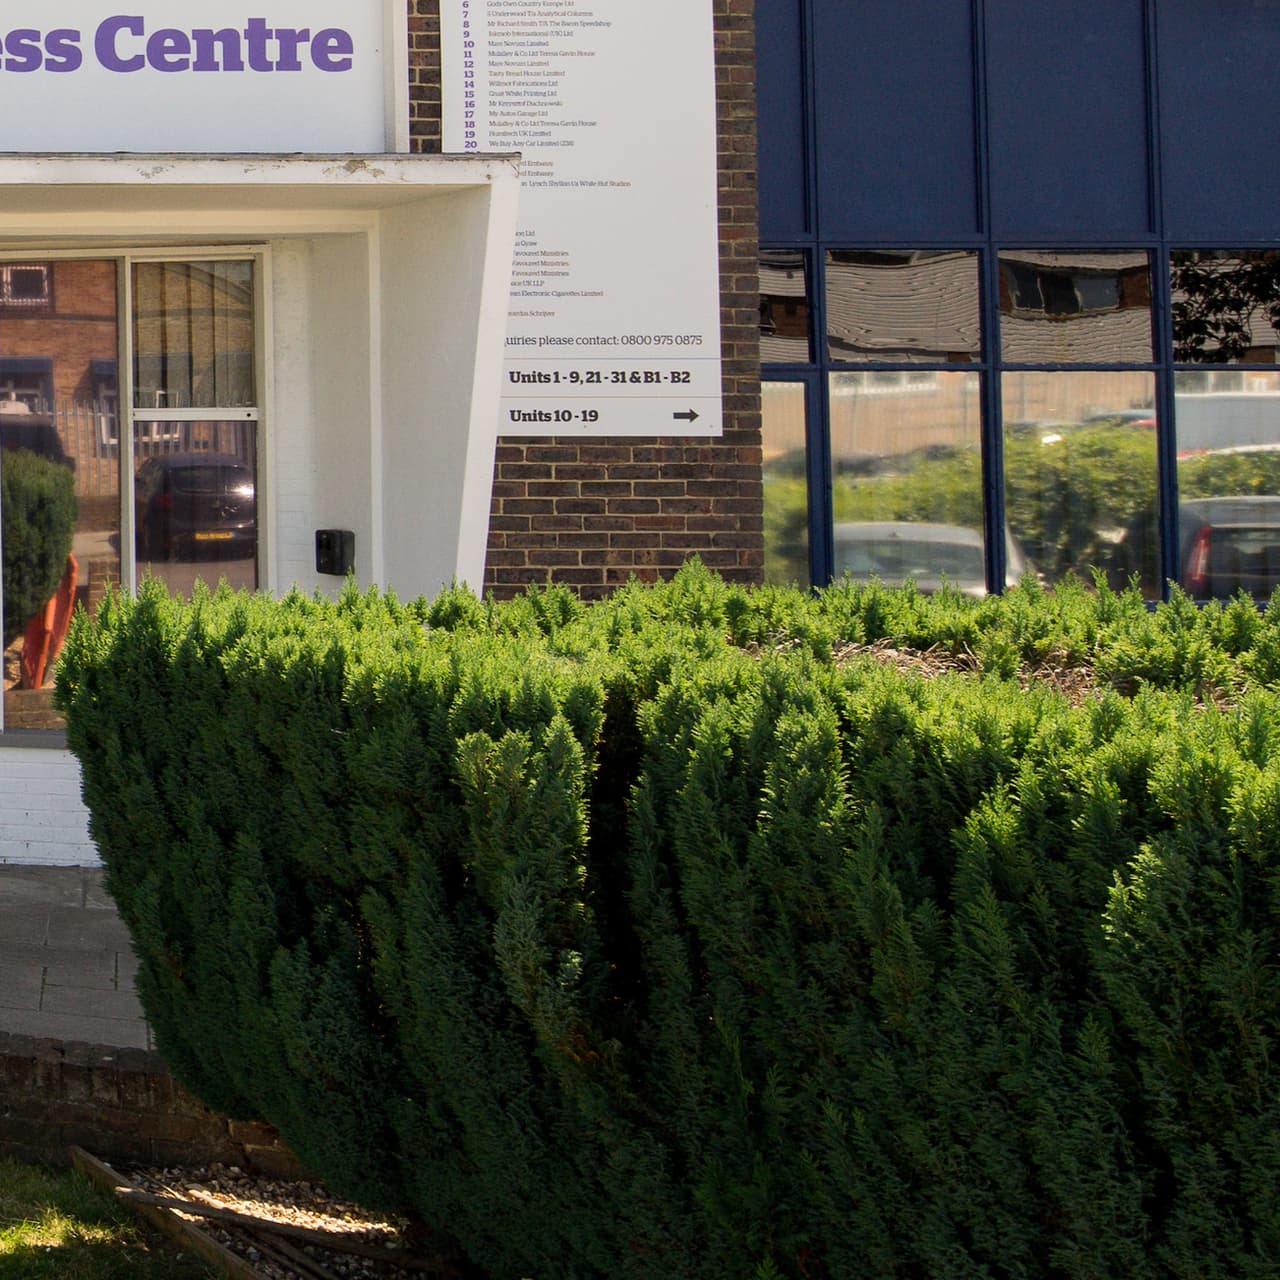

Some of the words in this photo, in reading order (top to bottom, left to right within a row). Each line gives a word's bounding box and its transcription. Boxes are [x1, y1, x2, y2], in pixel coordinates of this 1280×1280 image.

[93, 14, 355, 74] Centre
[504, 335, 537, 346] uiries
[538, 336, 574, 347] please
[576, 336, 620, 345] contact:
[621, 335, 652, 346] 0800
[654, 335, 673, 346] 975
[674, 335, 702, 346] 0875
[509, 371, 551, 384] Units
[553, 371, 560, 384] 1
[569, 371, 584, 385] 9,
[586, 371, 601, 384] 21
[610, 371, 627, 384] 31
[629, 371, 642, 384] &
[643, 371, 662, 384] B1
[670, 371, 691, 384] B2
[510, 410, 552, 422] Units
[554, 410, 572, 422] 10
[581, 410, 599, 422] 19
